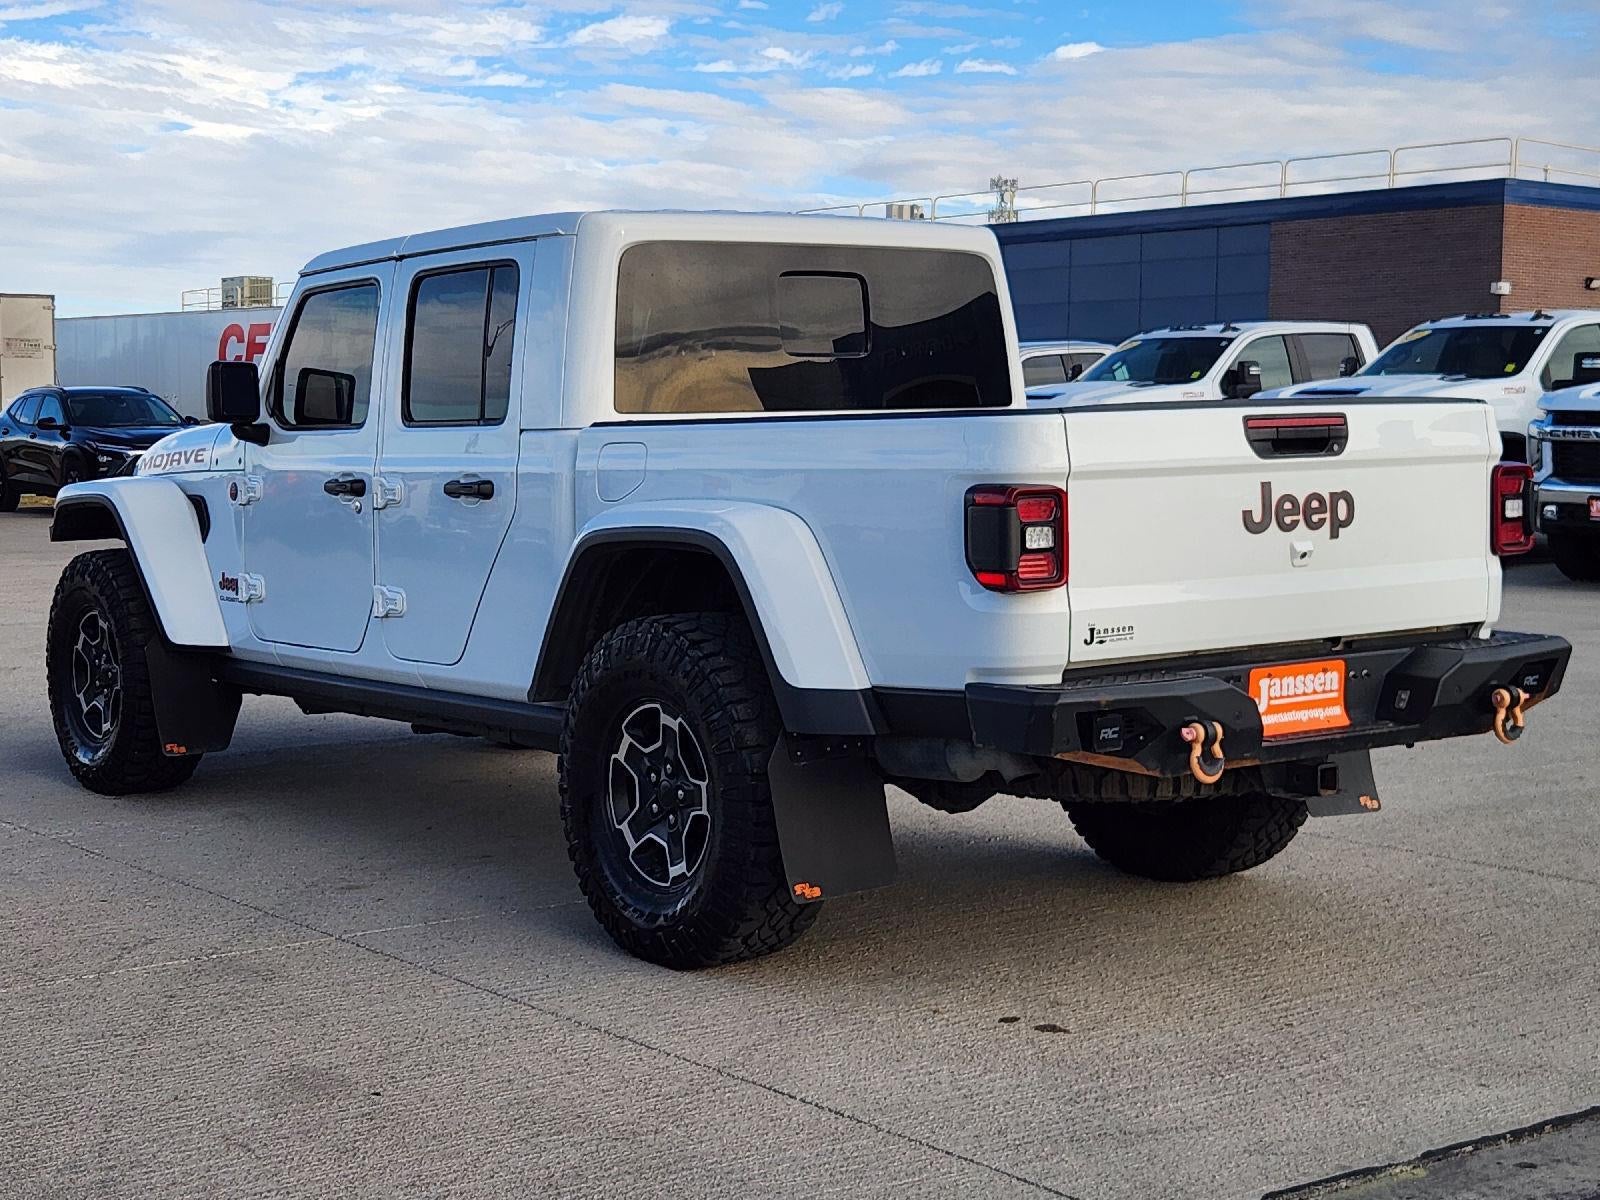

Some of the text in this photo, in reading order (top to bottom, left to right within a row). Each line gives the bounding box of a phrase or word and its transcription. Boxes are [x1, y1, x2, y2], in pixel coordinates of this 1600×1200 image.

[218, 322, 276, 362] CF
[140, 447, 206, 471] MOJAVE
[1242, 481, 1355, 540] Jeep
[1083, 625, 1134, 646] Janssen
[1255, 671, 1339, 713] Janssen
